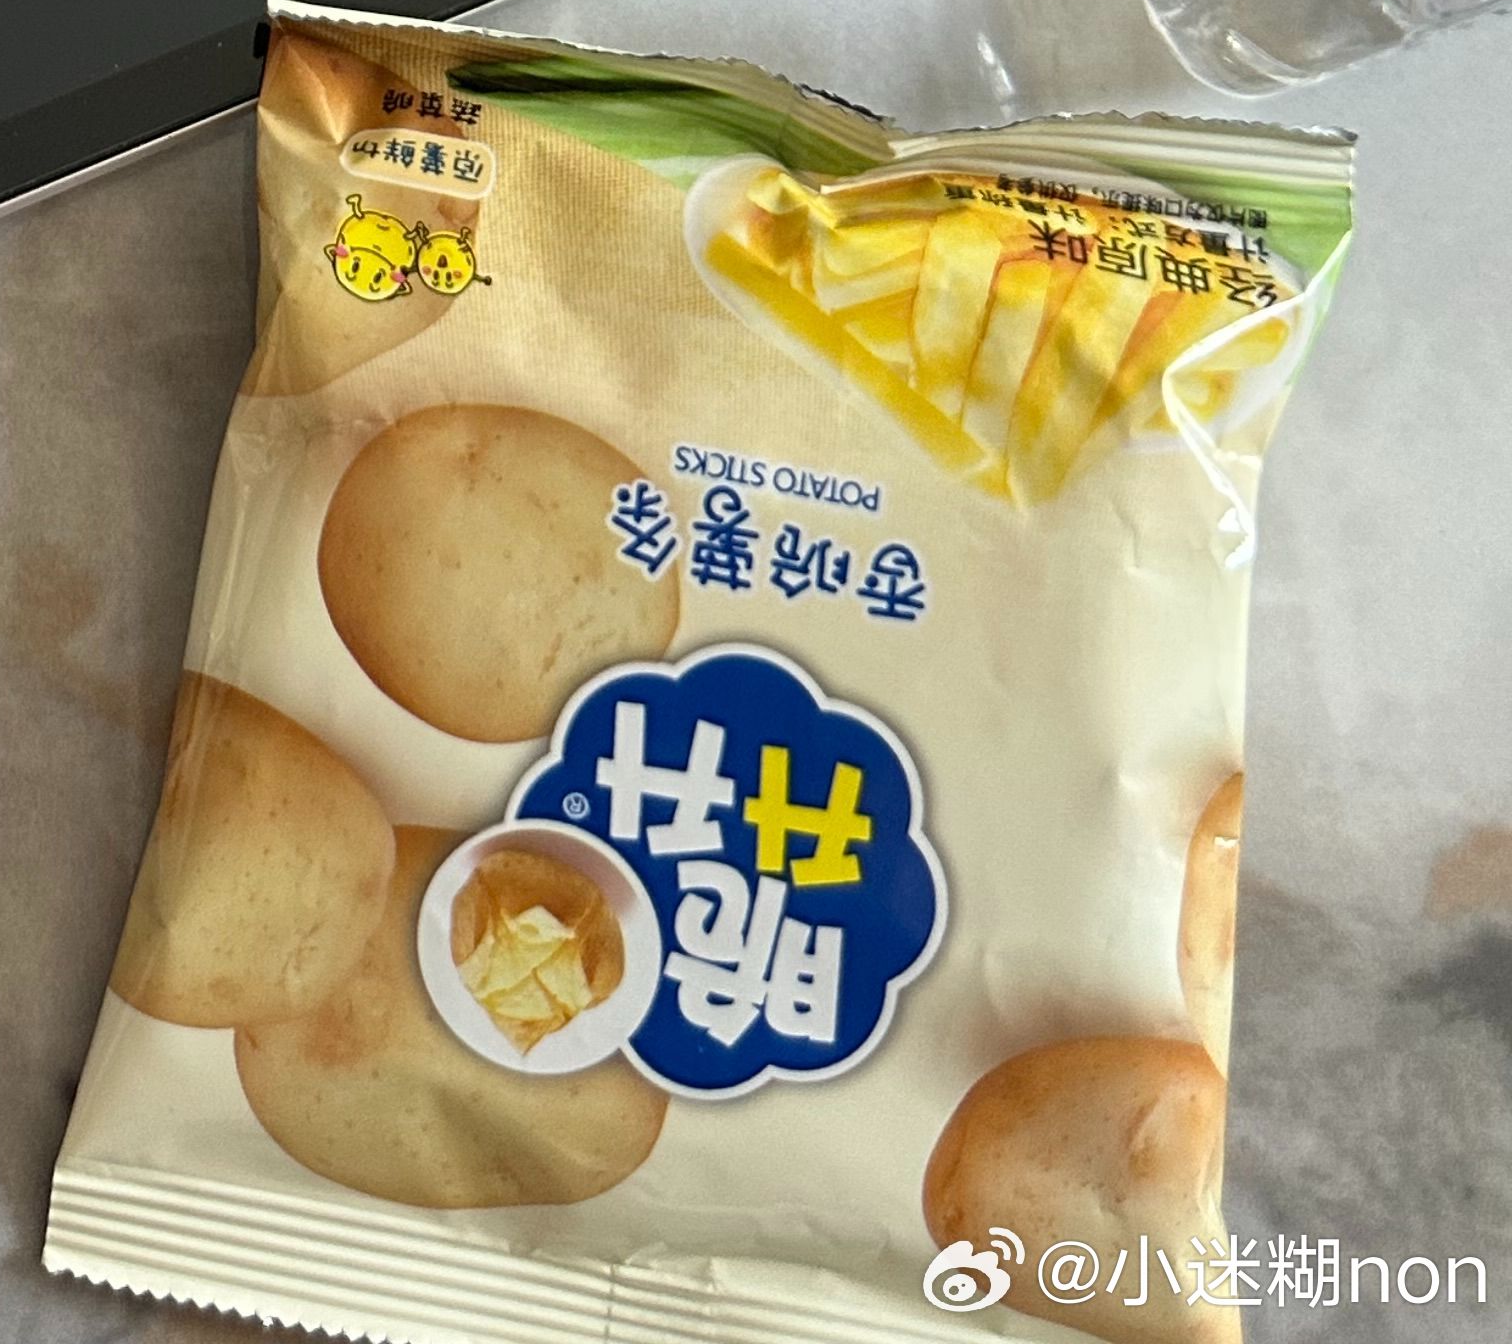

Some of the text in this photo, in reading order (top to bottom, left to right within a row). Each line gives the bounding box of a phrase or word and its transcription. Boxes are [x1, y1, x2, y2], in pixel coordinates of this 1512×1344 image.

[381, 88, 483, 125] 蔬菜脆
[352, 138, 484, 184] 原薯鲜切
[1028, 218, 1278, 309] 经典原味
[675, 445, 881, 512] POTATO STICKS
[609, 482, 926, 621] 香脆薯条
